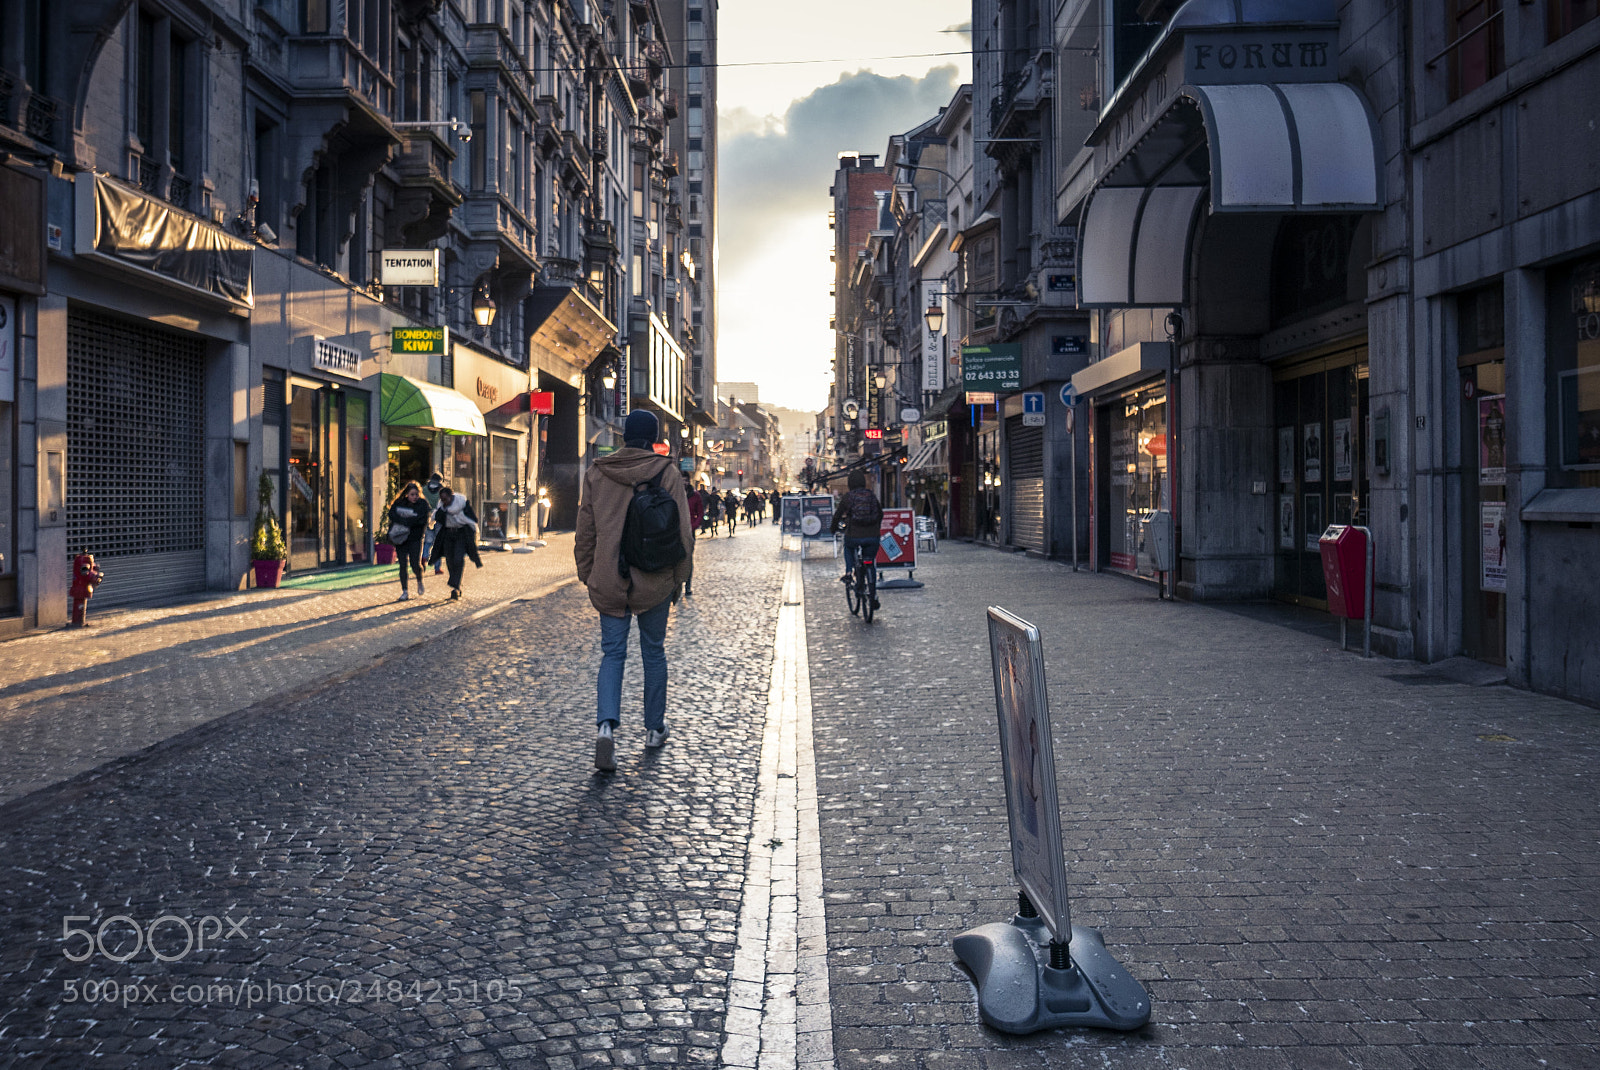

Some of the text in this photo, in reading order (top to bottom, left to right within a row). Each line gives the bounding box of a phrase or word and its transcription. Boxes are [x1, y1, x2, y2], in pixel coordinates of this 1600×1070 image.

[1194, 42, 1329, 70] FORUM
[385, 258, 433, 268] TENTATION
[395, 330, 443, 339] BONBONS
[403, 340, 433, 351] KIWI
[319, 341, 359, 372] TENTATION
[928, 355, 938, 387] DILLE
[965, 370, 1020, 381] 02 643 33 33
